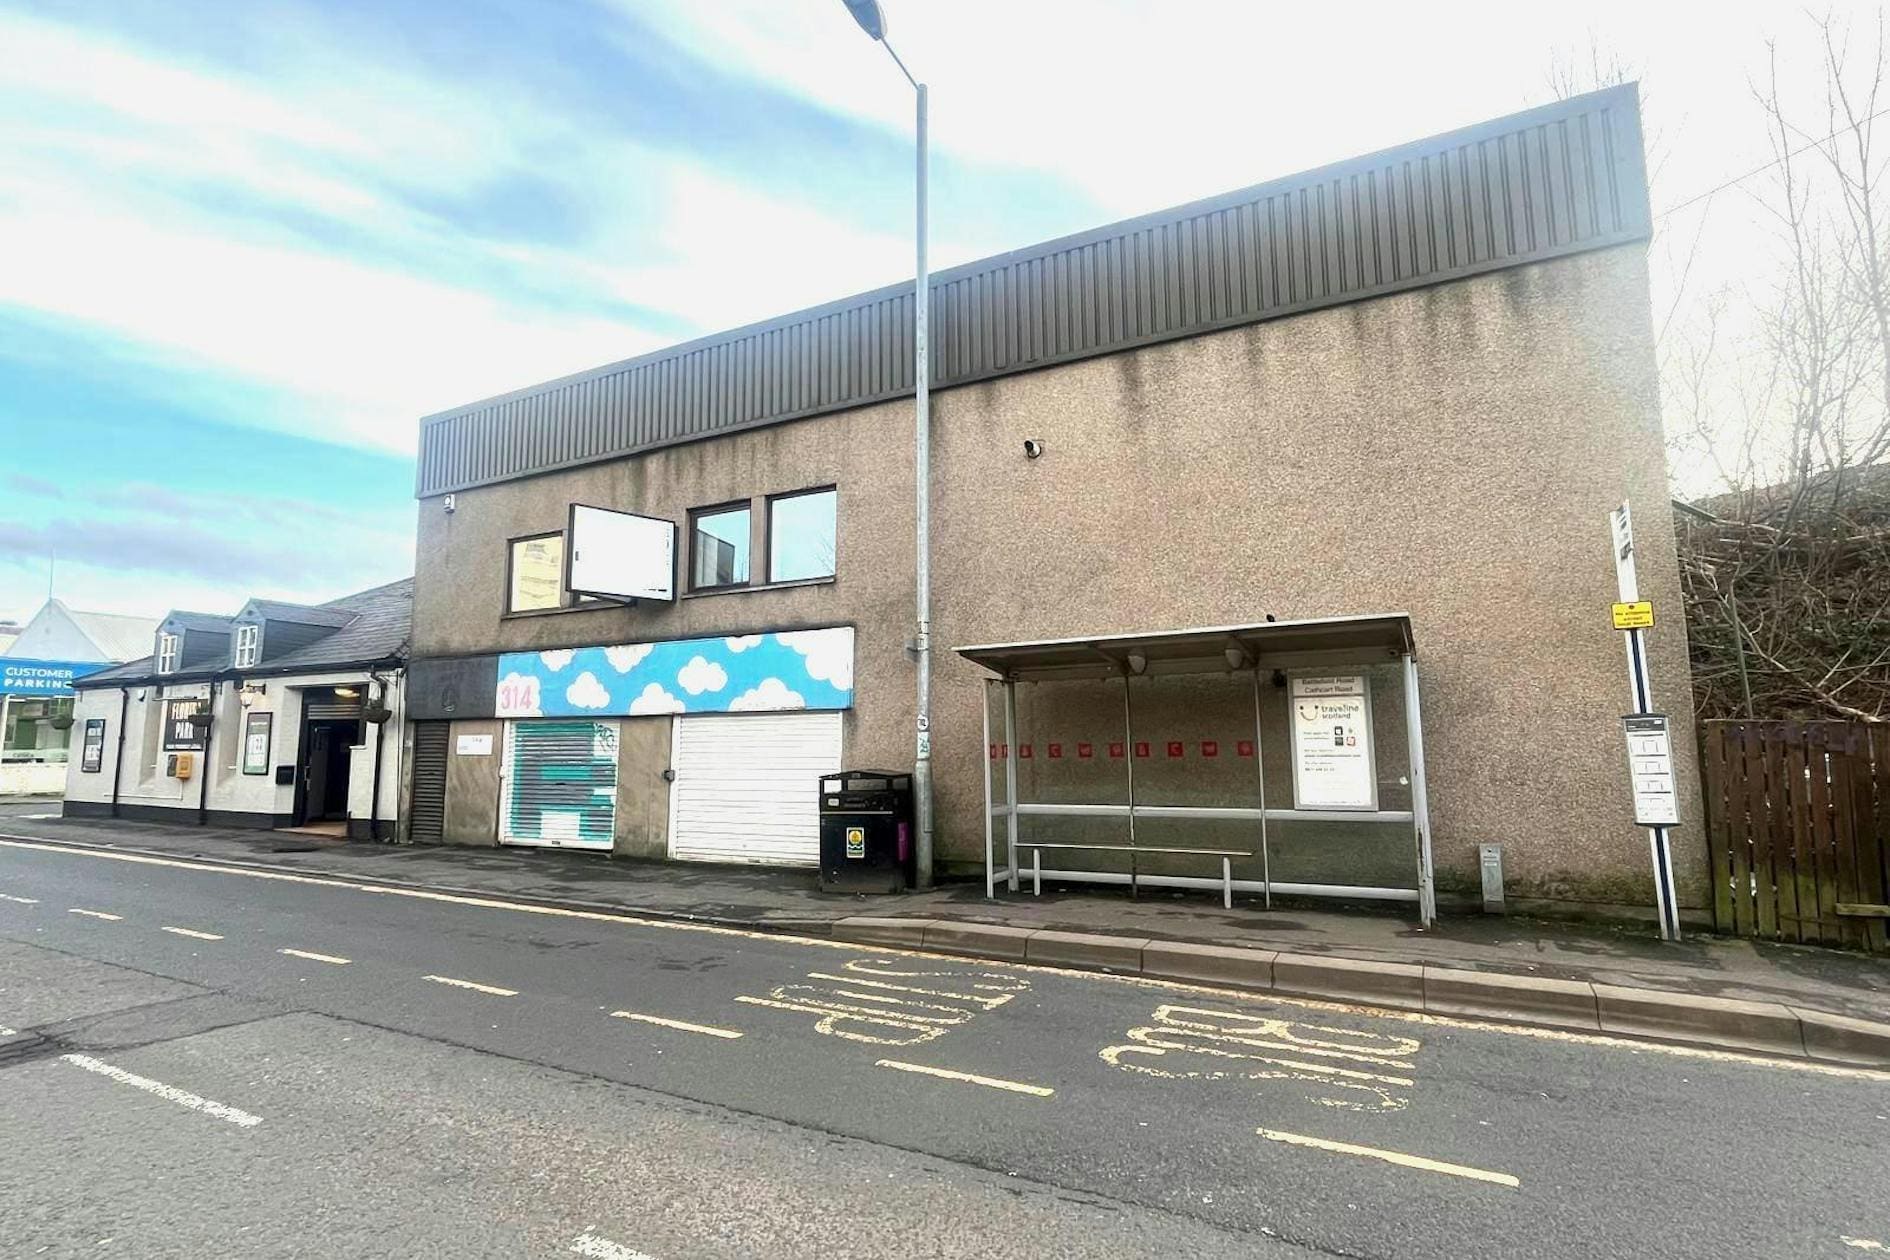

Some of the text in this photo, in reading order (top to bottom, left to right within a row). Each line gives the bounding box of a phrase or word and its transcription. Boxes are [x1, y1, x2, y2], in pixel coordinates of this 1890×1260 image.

[5, 666, 73, 679] CUSTOMER
[501, 685, 532, 710] 314
[1098, 1004, 1421, 1112] BUS
